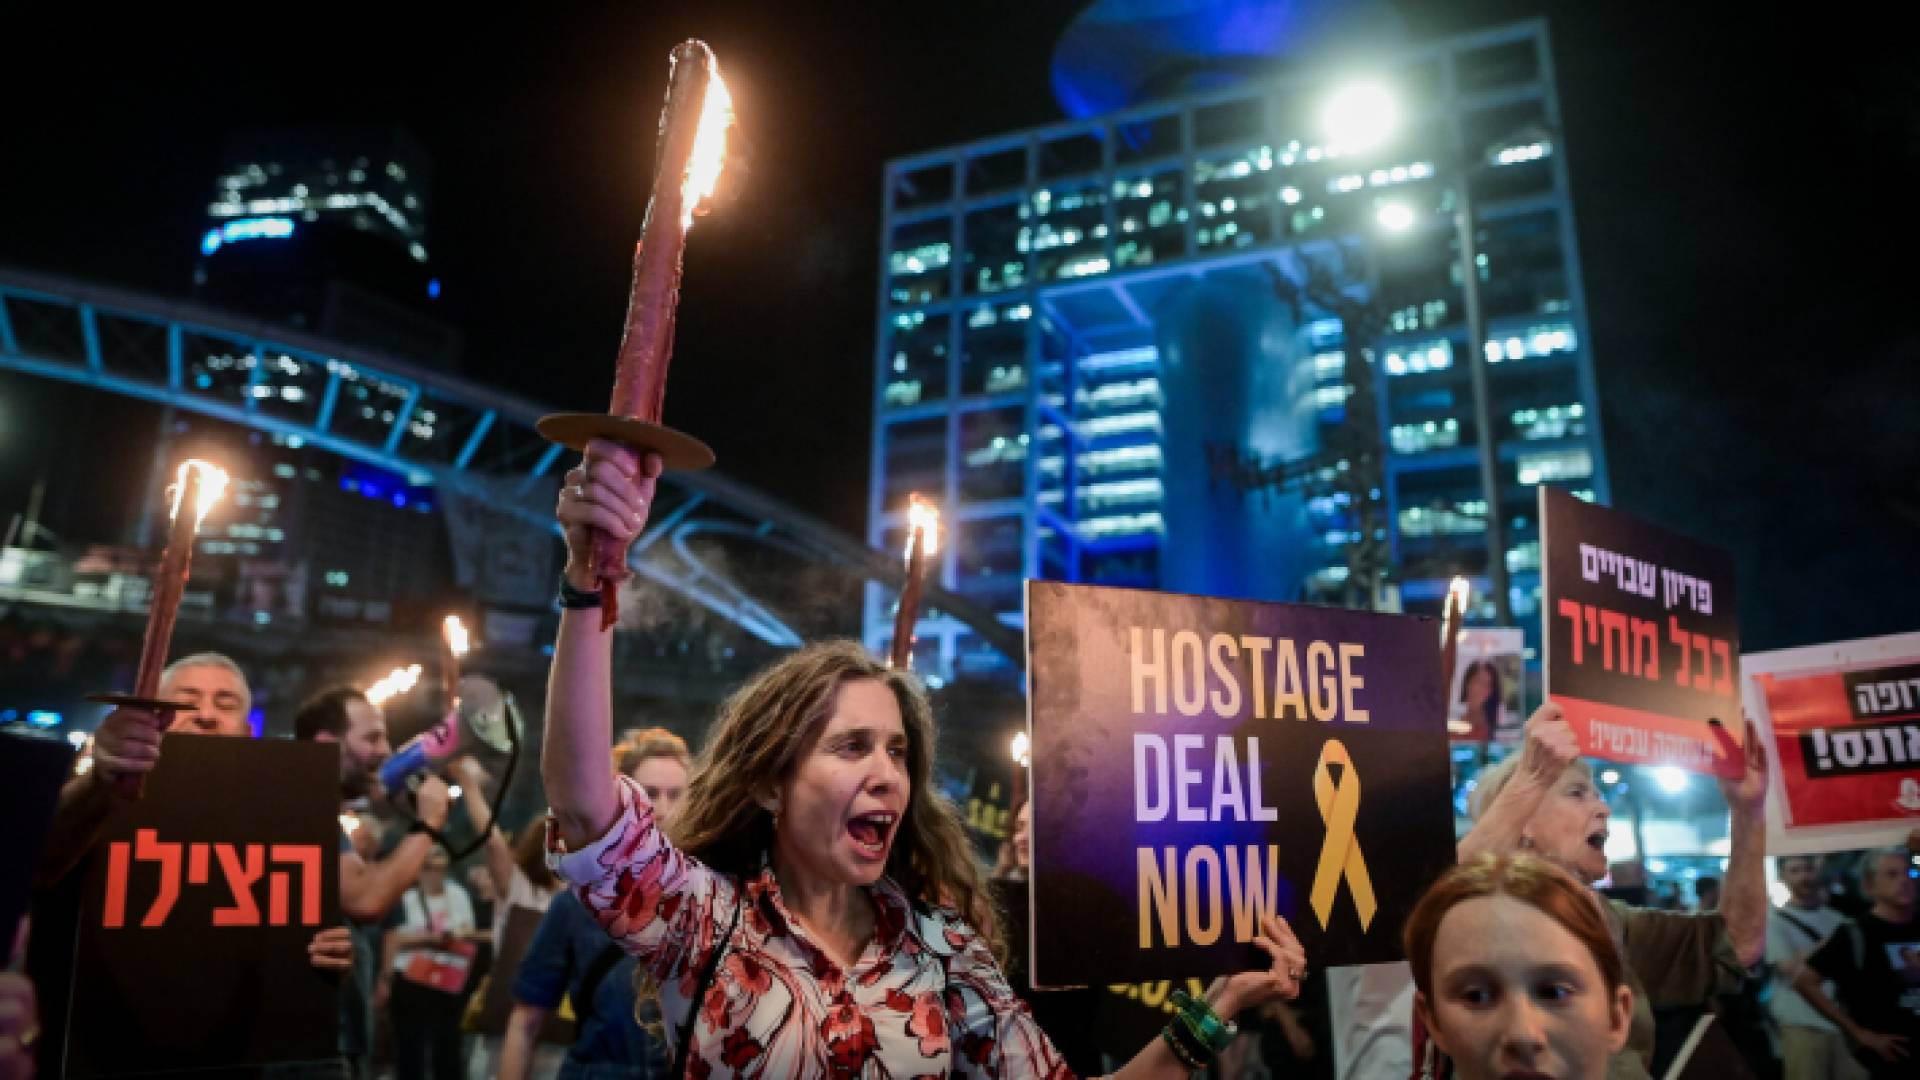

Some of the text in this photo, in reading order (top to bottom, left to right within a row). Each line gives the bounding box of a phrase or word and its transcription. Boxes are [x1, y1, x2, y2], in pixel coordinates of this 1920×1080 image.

[1579, 543, 1712, 615] פדיון שבויים
[1130, 628, 1370, 723] HOSTAGE
[1558, 598, 1733, 696] בכל מחיר
[1133, 734, 1278, 823] DEAL
[103, 828, 323, 928] הצילו
[1136, 844, 1280, 949] NOW
